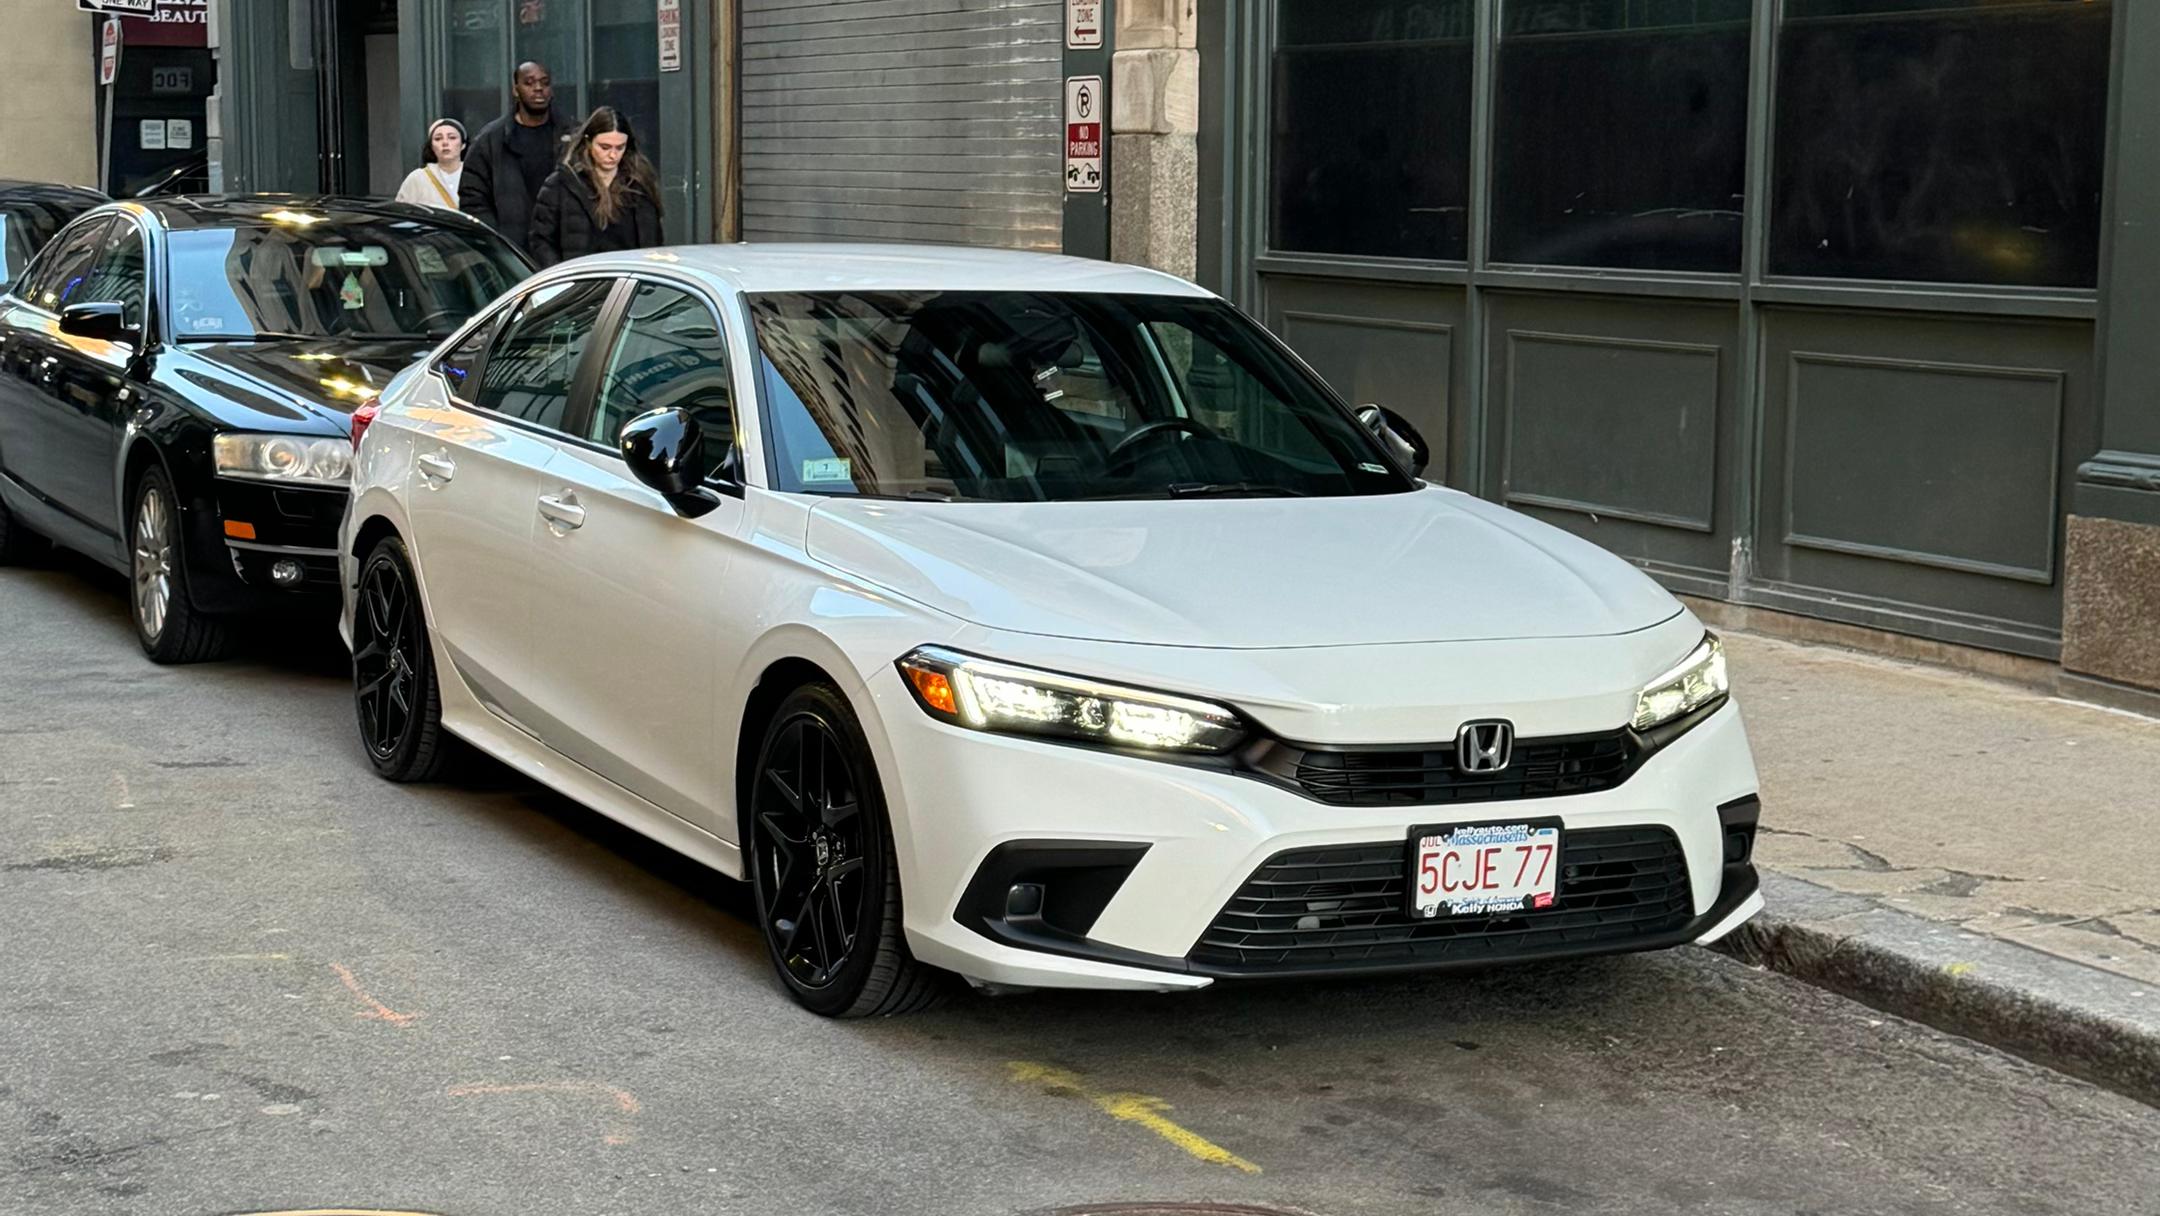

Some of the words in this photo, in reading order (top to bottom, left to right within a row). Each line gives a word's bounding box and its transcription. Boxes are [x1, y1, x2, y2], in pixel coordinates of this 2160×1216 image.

[127, 0, 148, 8] WAY
[1077, 8, 1094, 22] ZONE
[1080, 125, 1089, 139] NO
[1070, 141, 1098, 156] PARKING
[1422, 836, 1441, 847] JUL
[1421, 847, 1502, 894] 5CJE
[1513, 844, 1553, 888] 77
[1452, 902, 1485, 915] Kelly
[1487, 901, 1525, 912] HONDA
